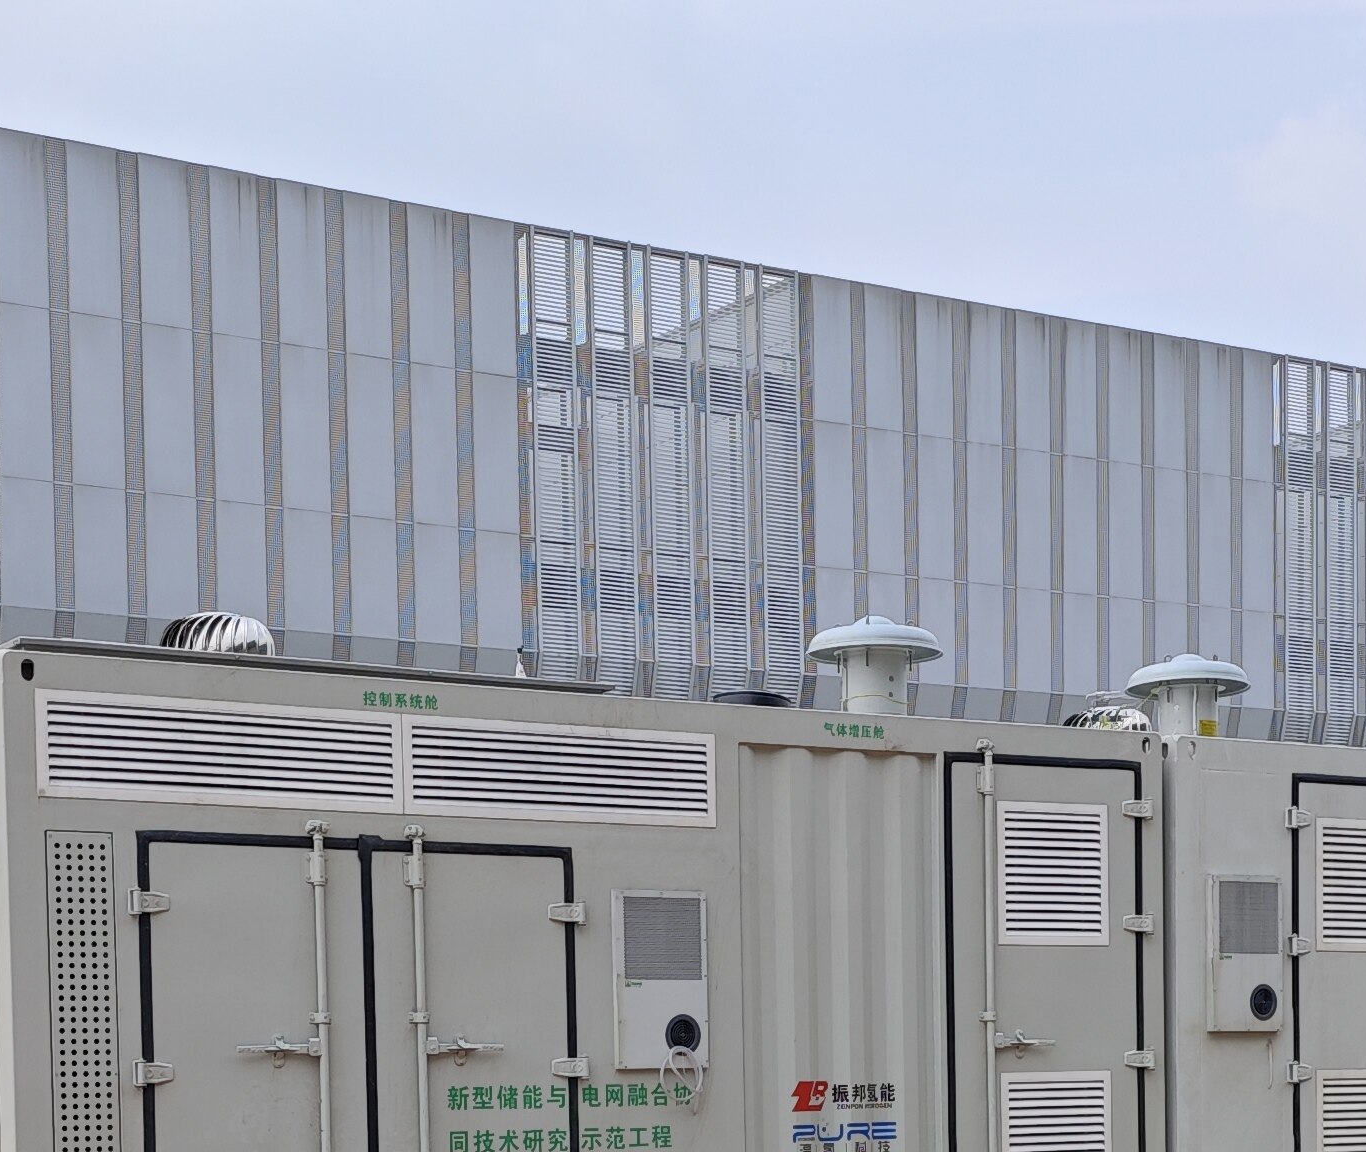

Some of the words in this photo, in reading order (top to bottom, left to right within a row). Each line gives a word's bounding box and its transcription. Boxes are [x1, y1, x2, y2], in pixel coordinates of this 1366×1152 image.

[362, 690, 439, 711] 控制系统舱
[823, 721, 885, 740] 气体增压舱
[831, 1082, 896, 1103] 振邦氢能
[792, 1121, 897, 1143] PURE
